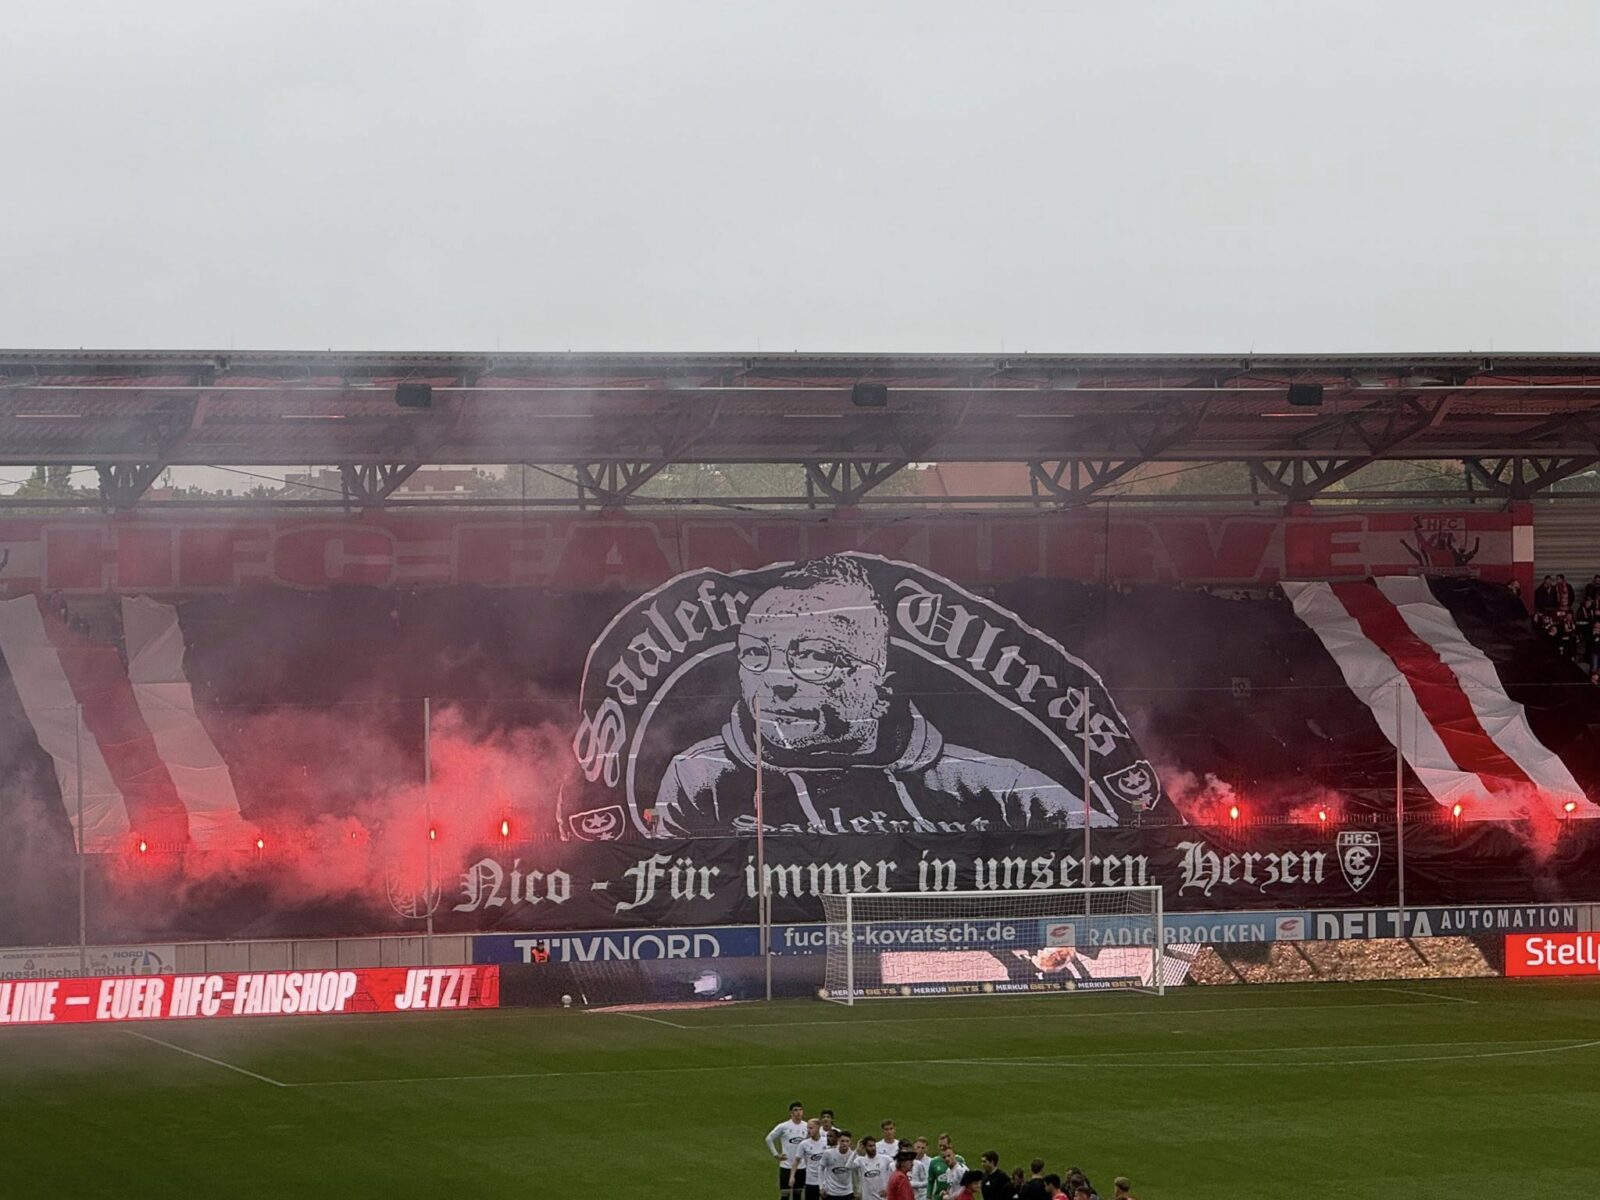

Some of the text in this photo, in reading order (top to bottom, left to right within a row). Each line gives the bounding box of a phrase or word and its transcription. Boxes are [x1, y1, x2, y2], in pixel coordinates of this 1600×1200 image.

[894, 578, 1130, 756] Ultras
[1345, 833, 1372, 844] HFC
[452, 857, 572, 912] Nico
[615, 853, 720, 915] Für
[744, 855, 898, 899] immer
[918, 849, 958, 892] in
[974, 851, 1148, 890] unseren
[1174, 841, 1328, 897] Herzen
[784, 922, 1016, 947] fuchs-kovatsch.de
[1163, 923, 1265, 944] BROCKEN
[1317, 908, 1574, 940] DELTA AUTOMATION
[113, 951, 144, 959] NORD
[1526, 936, 1600, 970] Stell
[0, 965, 126, 980] gesellschat mbH
[0, 982, 59, 1022] LINE
[96, 978, 165, 1020] EUER
[169, 971, 357, 1017] HFC-FANSHOP
[394, 968, 477, 1009] JETZT
[913, 985, 979, 994] MERKUR BETS
[995, 983, 1029, 991] MERKUR
